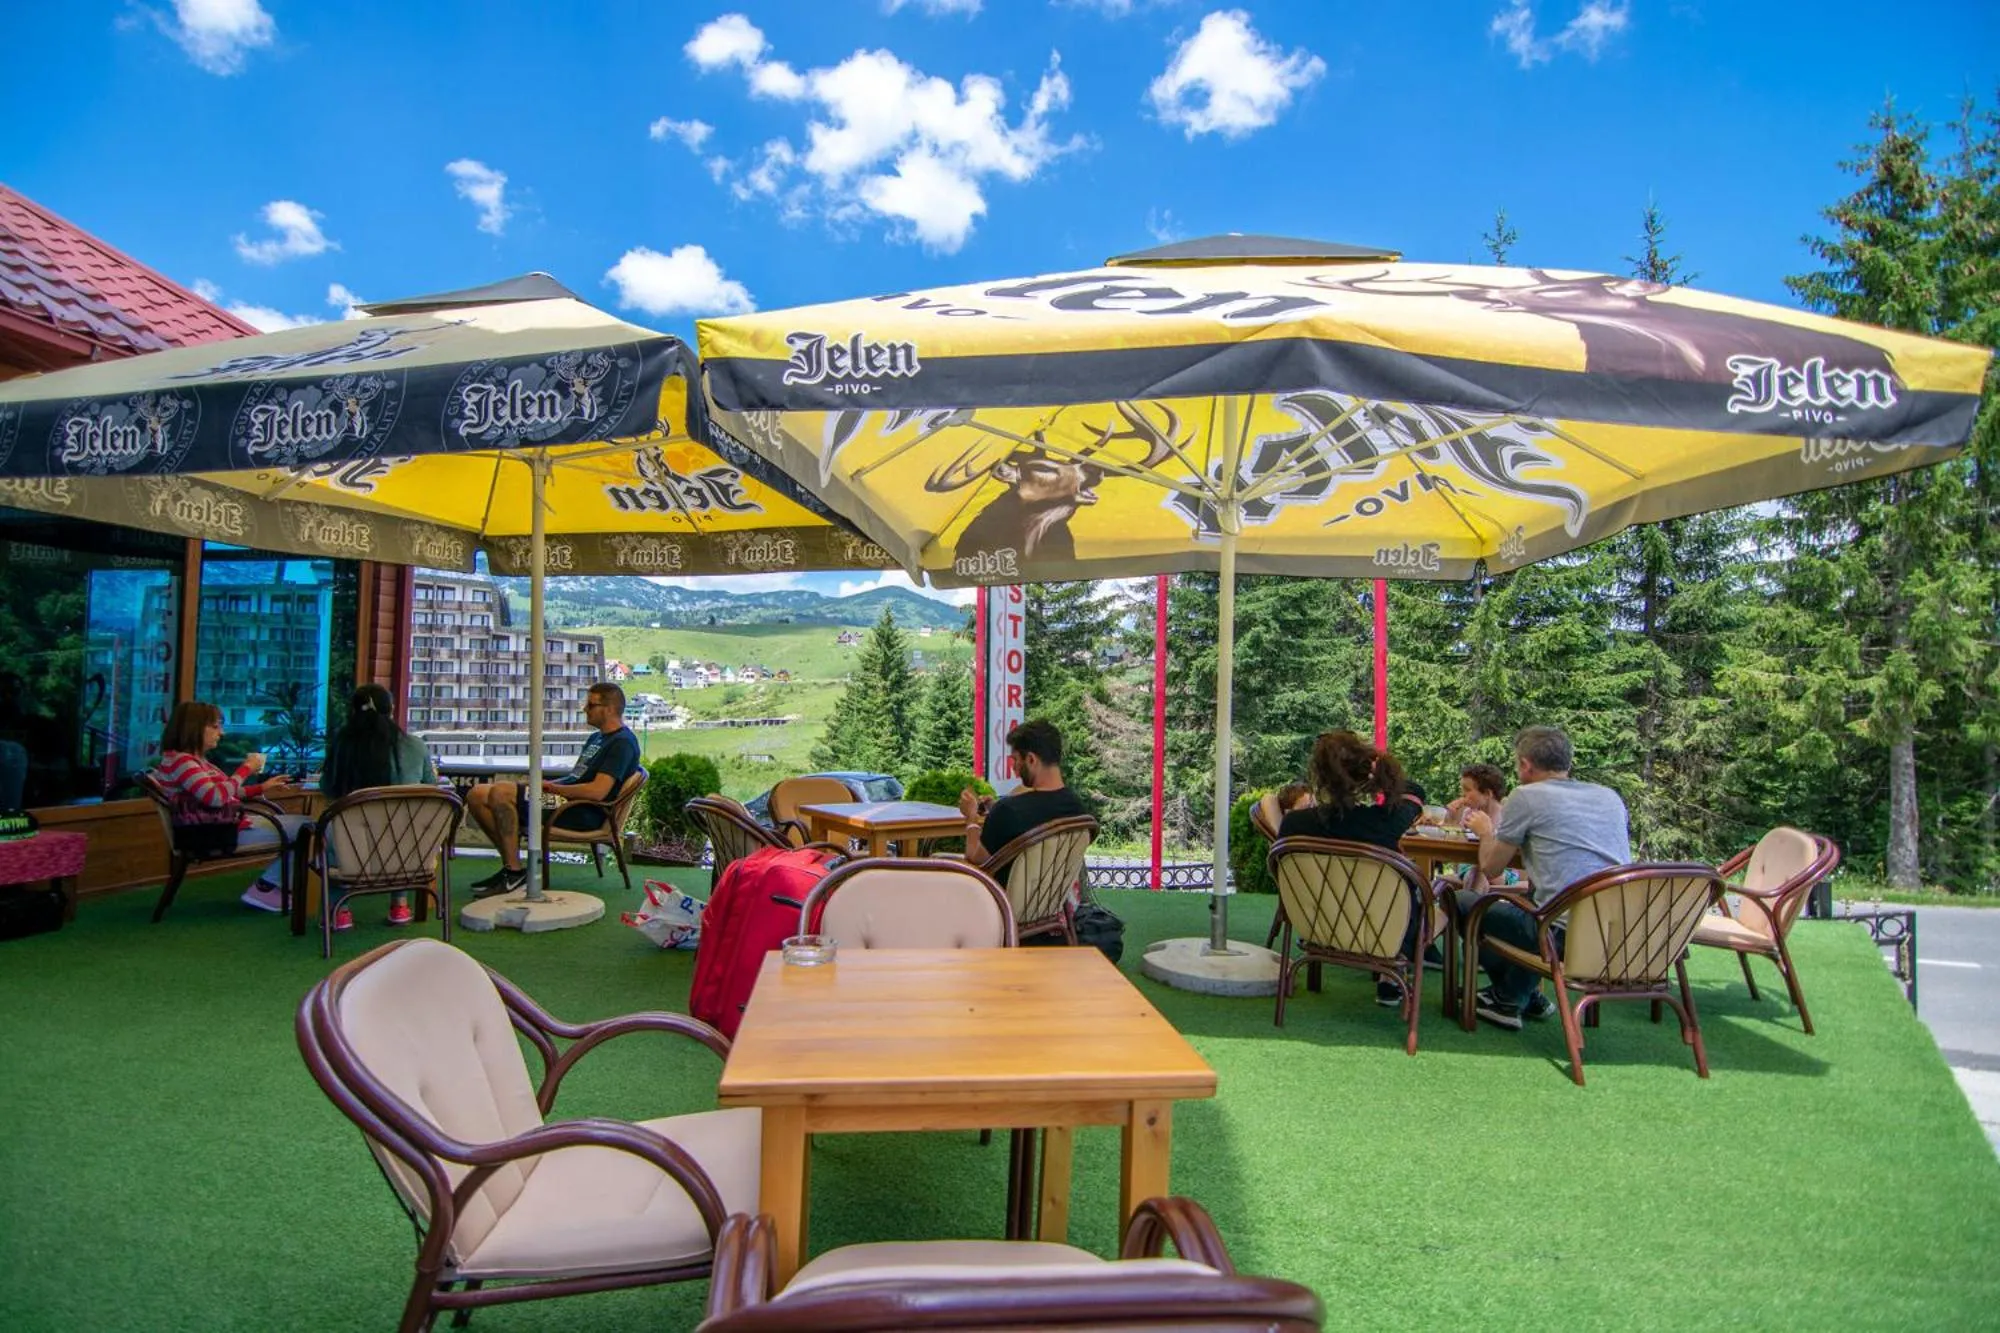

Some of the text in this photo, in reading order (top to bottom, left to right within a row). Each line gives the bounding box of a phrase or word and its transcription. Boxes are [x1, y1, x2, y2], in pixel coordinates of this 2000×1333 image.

[782, 330, 922, 386] Jelen
[1725, 353, 1899, 414] Jelen
[248, 400, 338, 455] Jelen
[459, 379, 562, 436] Jelen
[62, 415, 143, 462] Jelen
